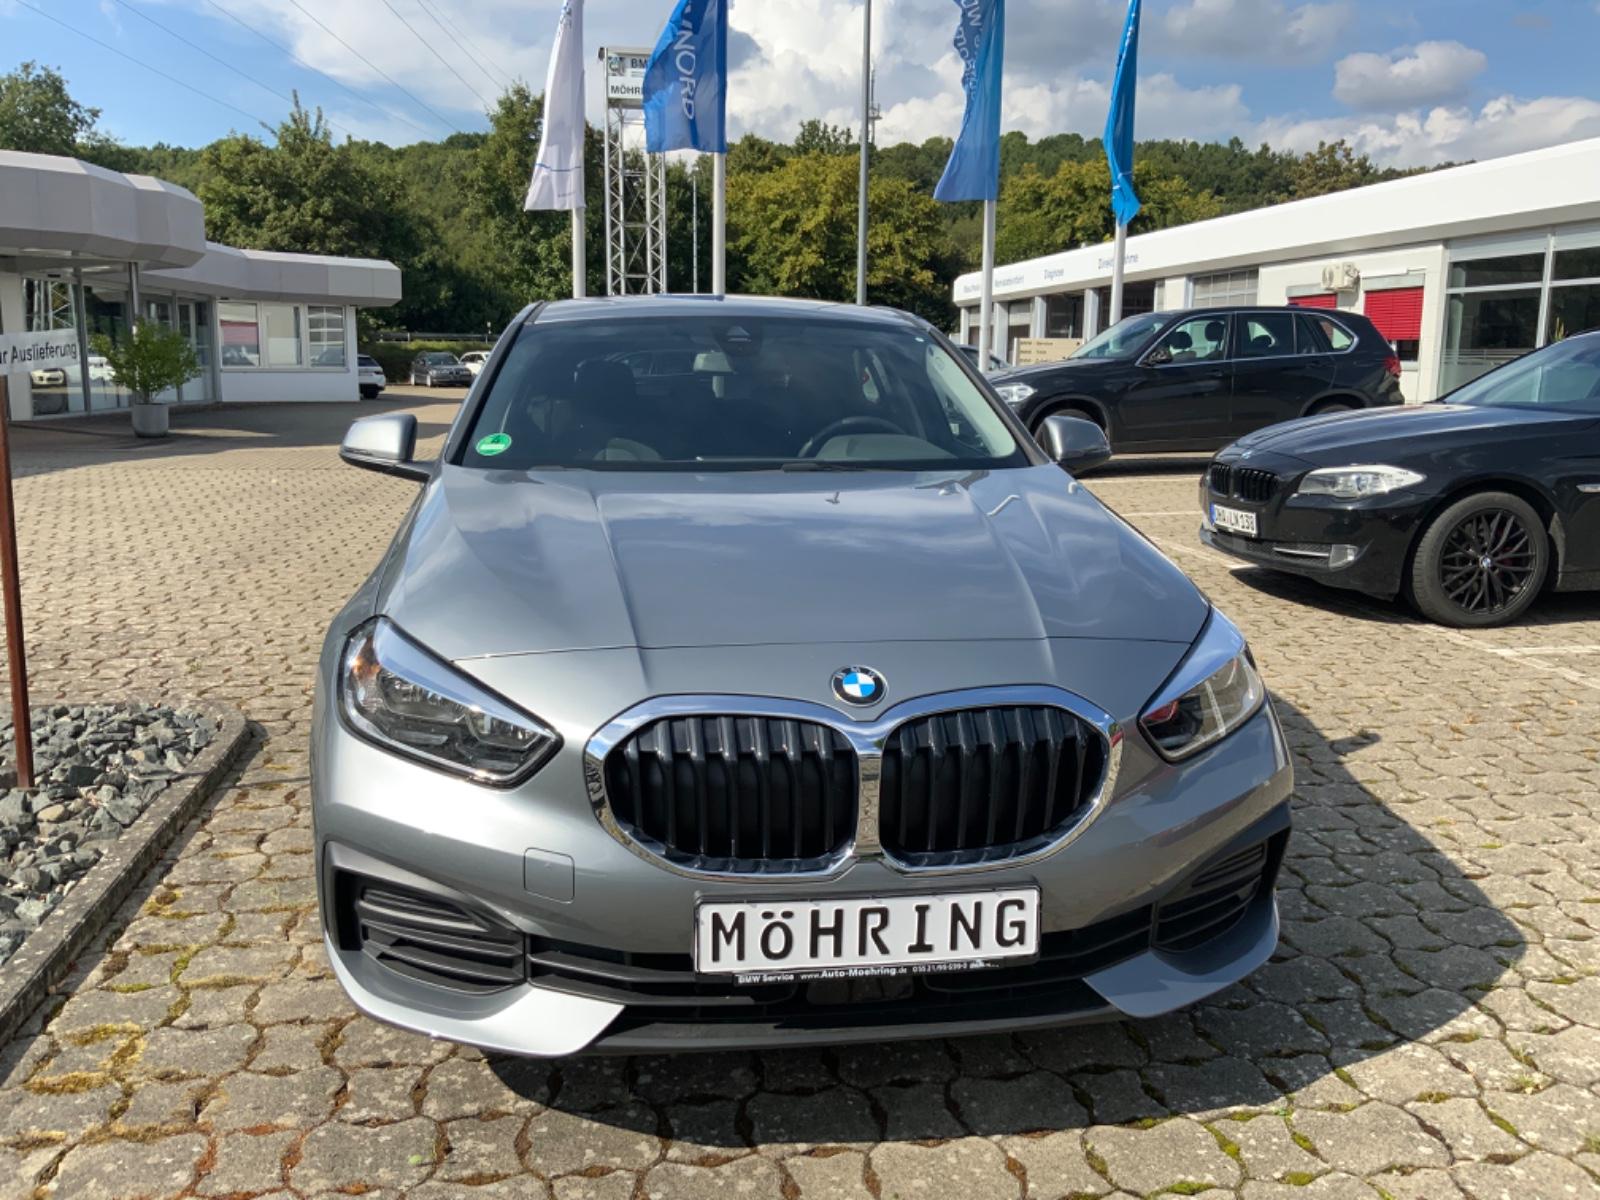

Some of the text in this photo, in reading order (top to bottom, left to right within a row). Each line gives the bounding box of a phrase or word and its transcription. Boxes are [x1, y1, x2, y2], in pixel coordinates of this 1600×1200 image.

[631, 58, 648, 69] BM
[610, 84, 643, 95] MÖHR
[11, 342, 77, 363] Auslieferung
[711, 898, 1027, 962] MÖHRING
[762, 973, 795, 982] Service
